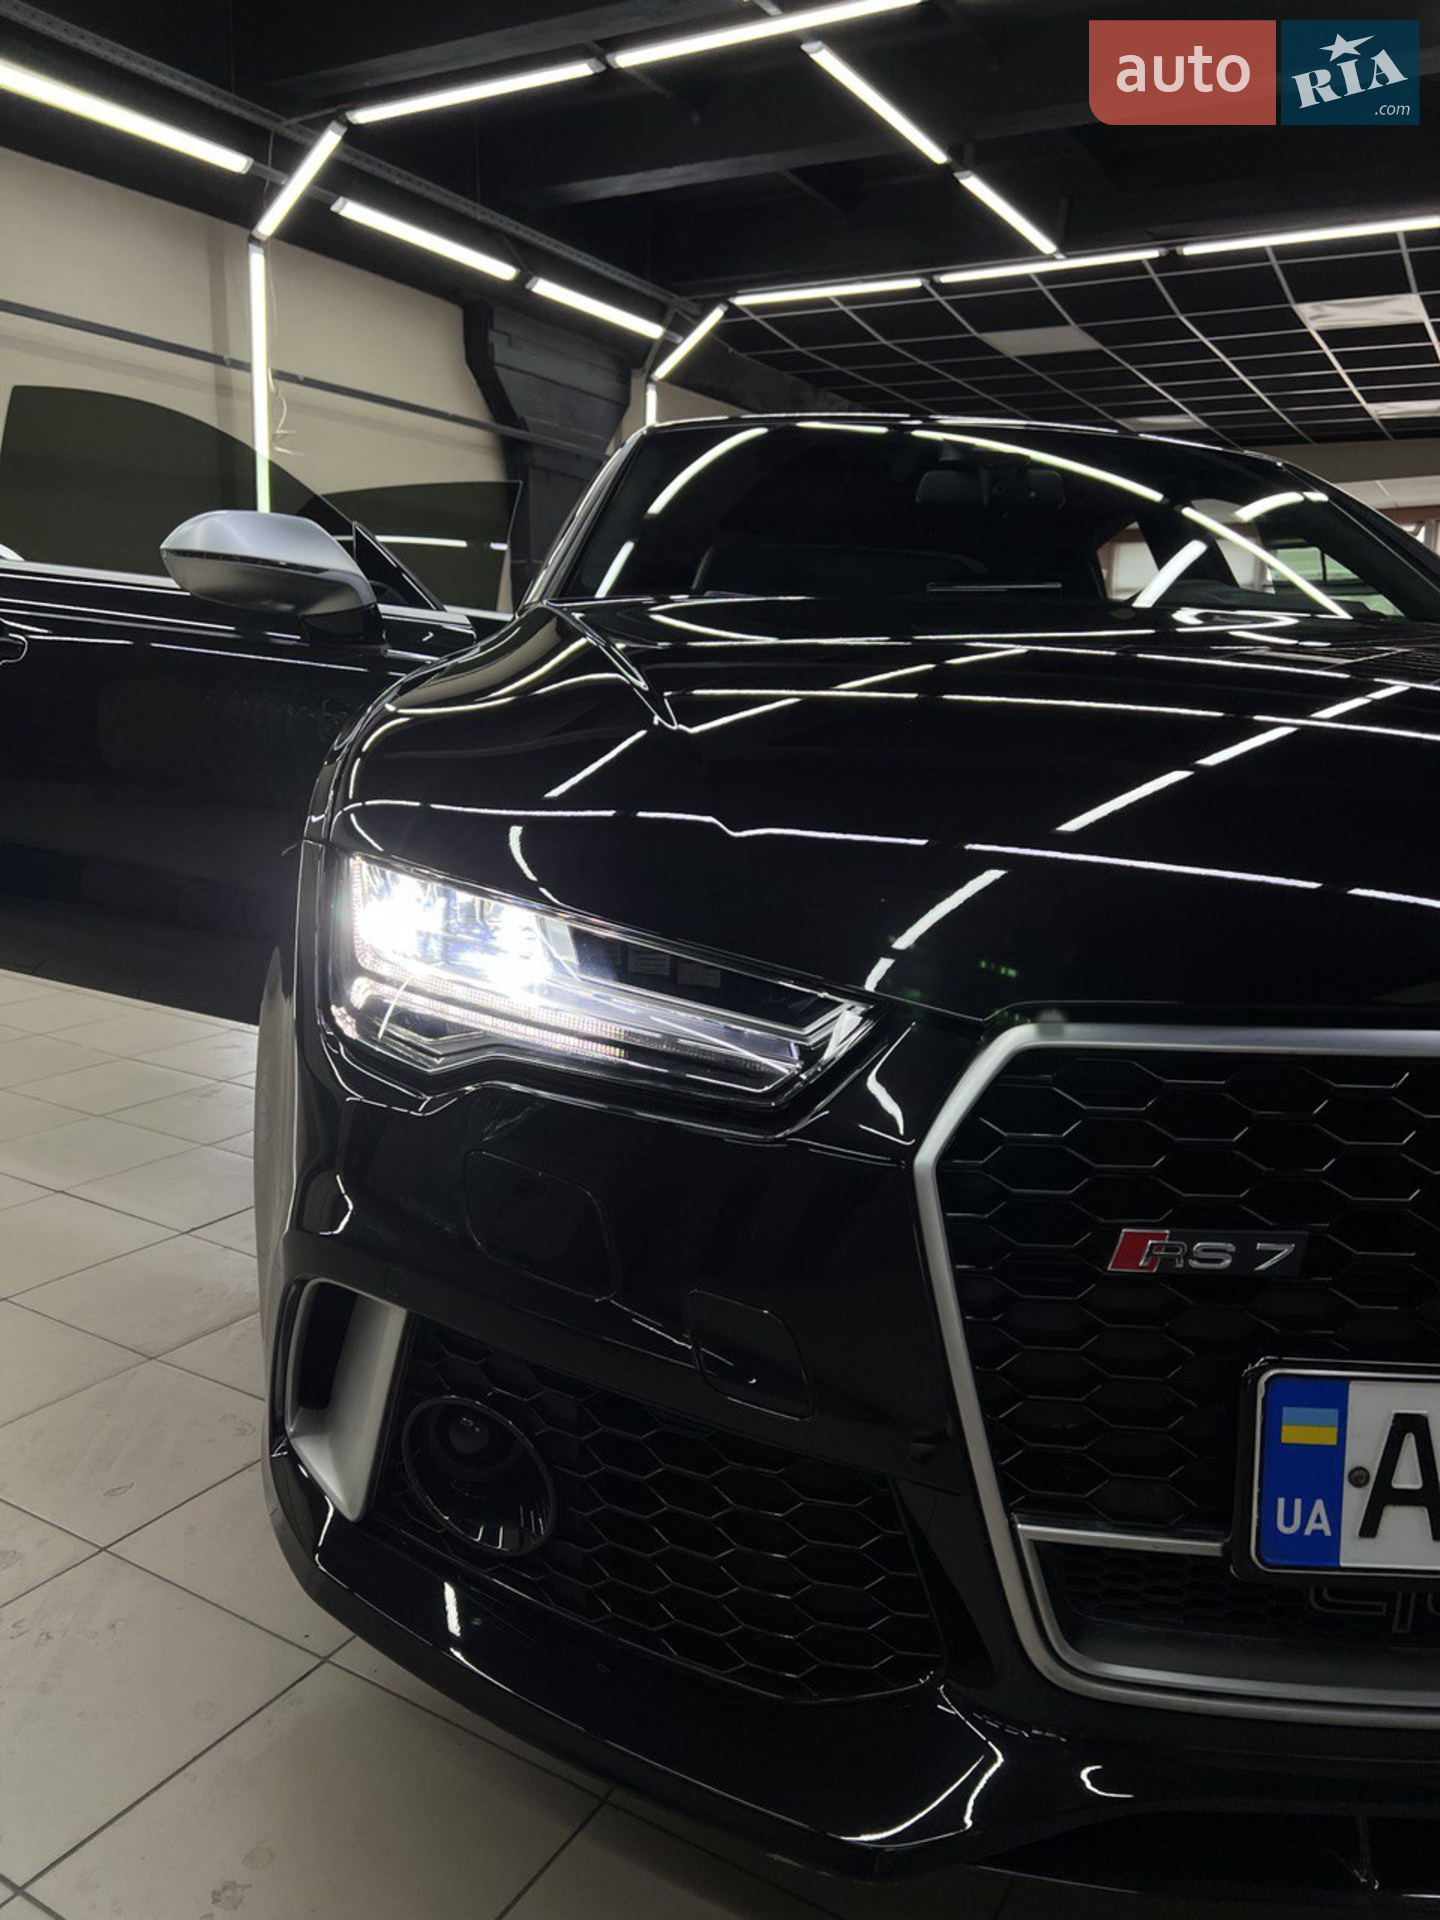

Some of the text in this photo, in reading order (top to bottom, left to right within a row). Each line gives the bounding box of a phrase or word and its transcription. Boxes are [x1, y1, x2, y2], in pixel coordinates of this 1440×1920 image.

[1137, 1239, 1296, 1272] RS 7
[1276, 1497, 1332, 1537] UA
